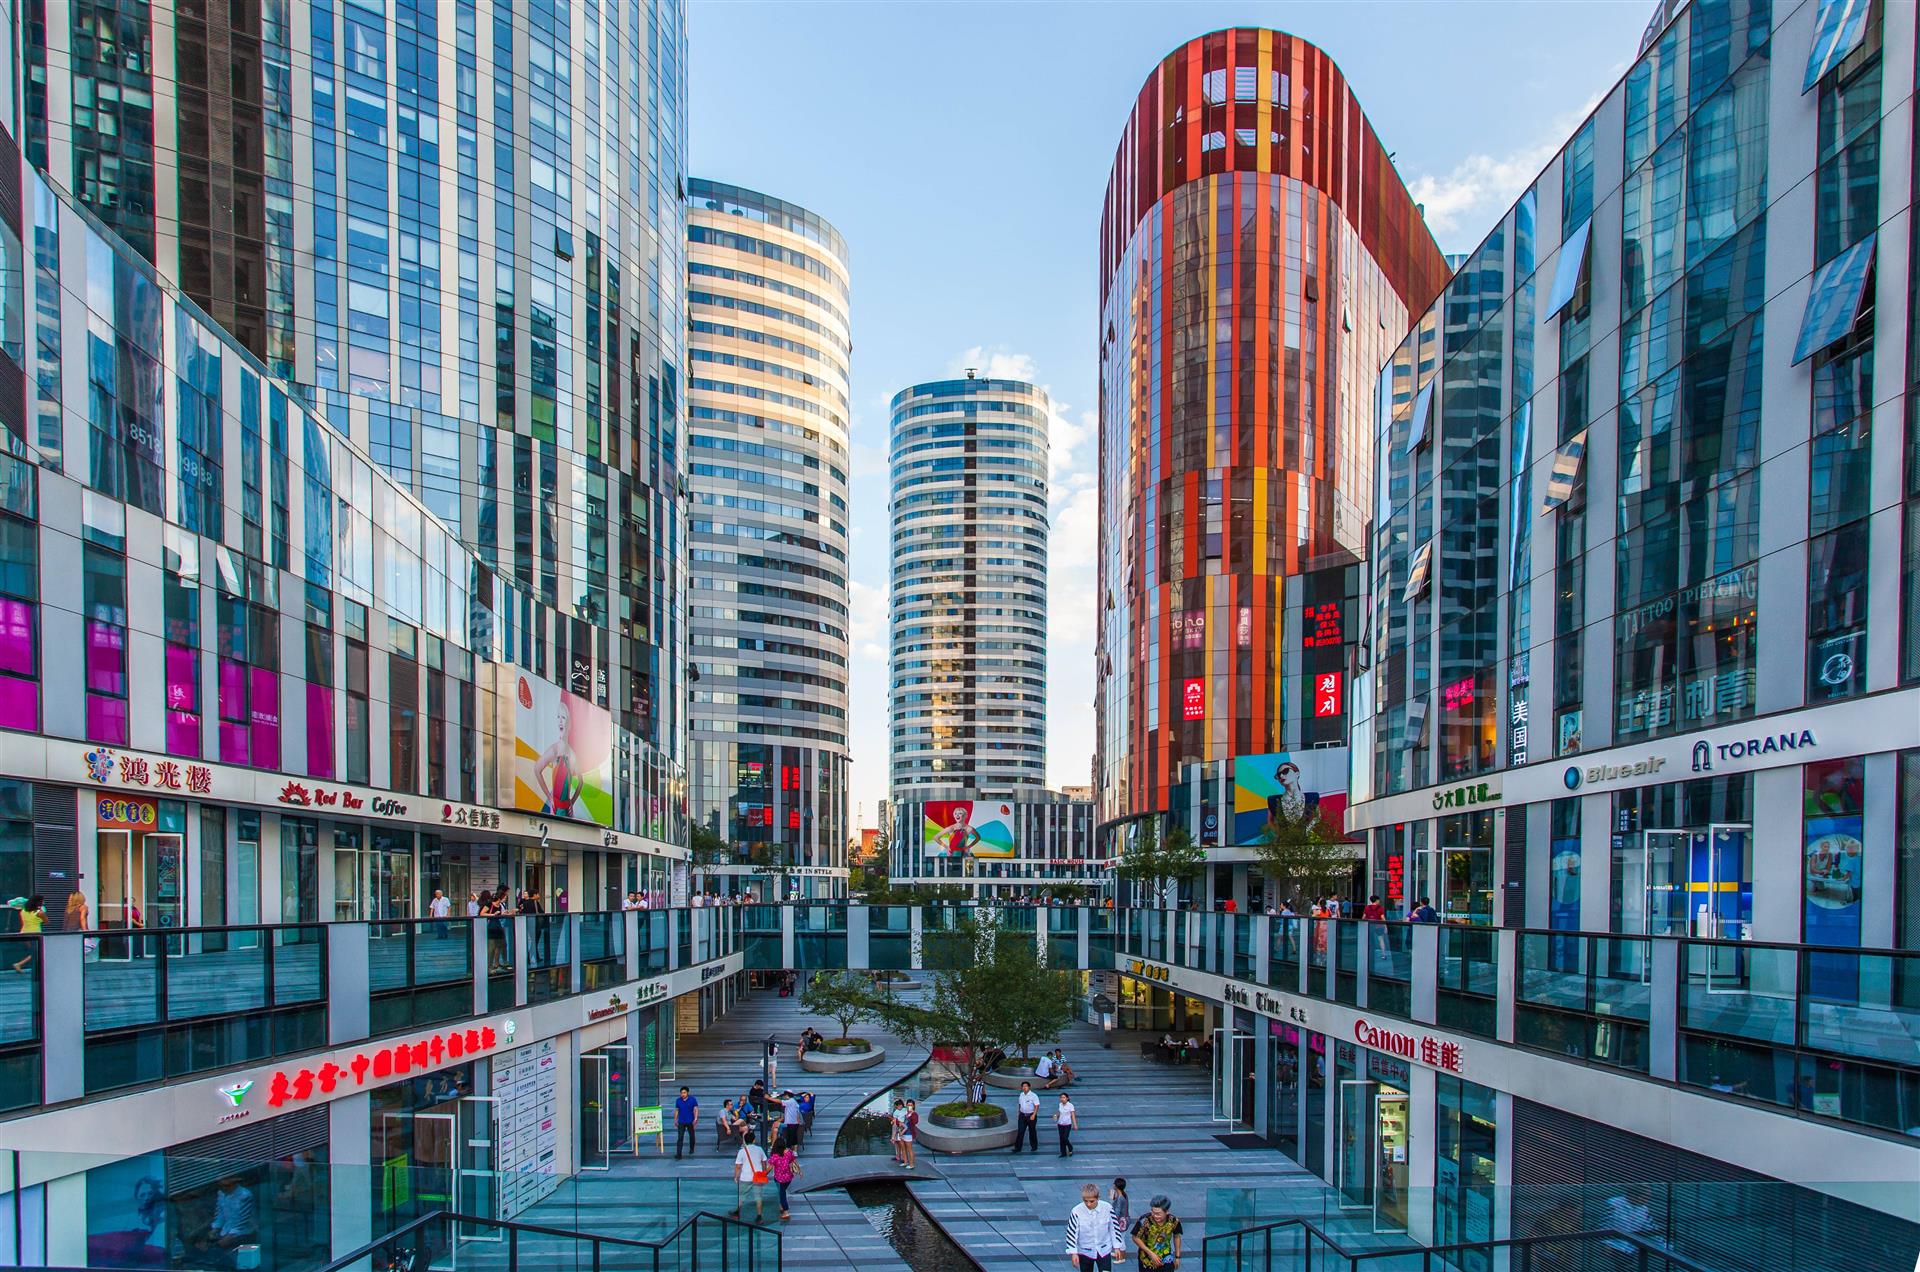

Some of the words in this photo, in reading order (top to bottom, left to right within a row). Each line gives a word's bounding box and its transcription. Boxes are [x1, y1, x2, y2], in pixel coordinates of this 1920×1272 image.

[1622, 598, 1673, 643] TATTOO
[1686, 566, 1756, 604] PIERCING
[1717, 730, 1816, 760] TORANA
[1586, 756, 1666, 783] Blueair
[314, 788, 337, 806] Red
[343, 791, 363, 809] Bar
[372, 797, 407, 816] Coffee
[538, 822, 550, 848] 2
[1354, 1019, 1417, 1059] Canon
[1420, 1035, 1463, 1073] 佳能
